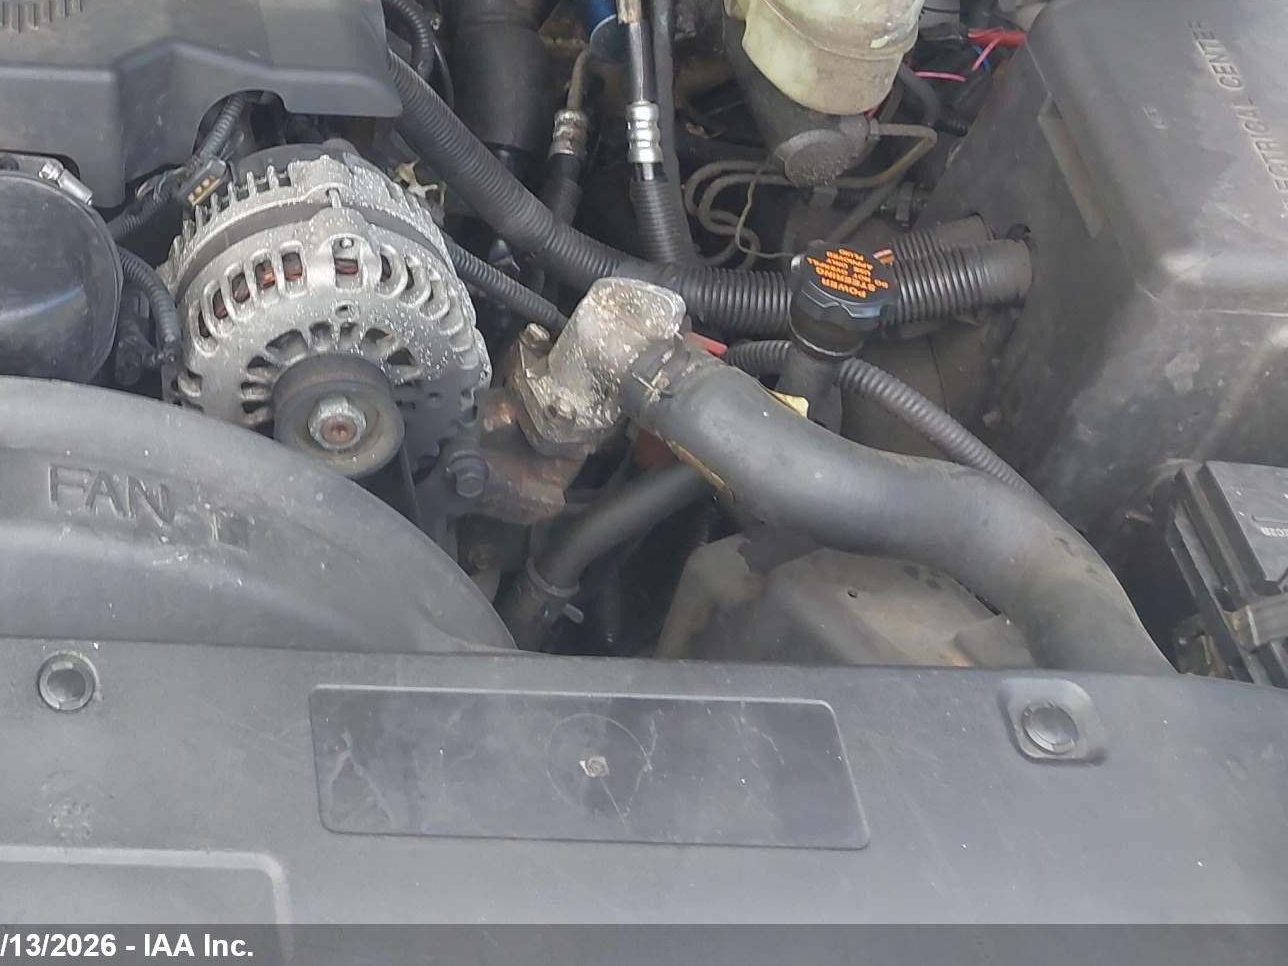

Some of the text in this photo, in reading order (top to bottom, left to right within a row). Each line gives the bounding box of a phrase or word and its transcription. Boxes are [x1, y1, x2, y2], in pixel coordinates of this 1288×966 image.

[815, 266, 877, 292] STEERING
[821, 277, 867, 299] POWER
[853, 273, 872, 283] NOT
[874, 278, 889, 290] DO
[47, 464, 175, 527] FAN
